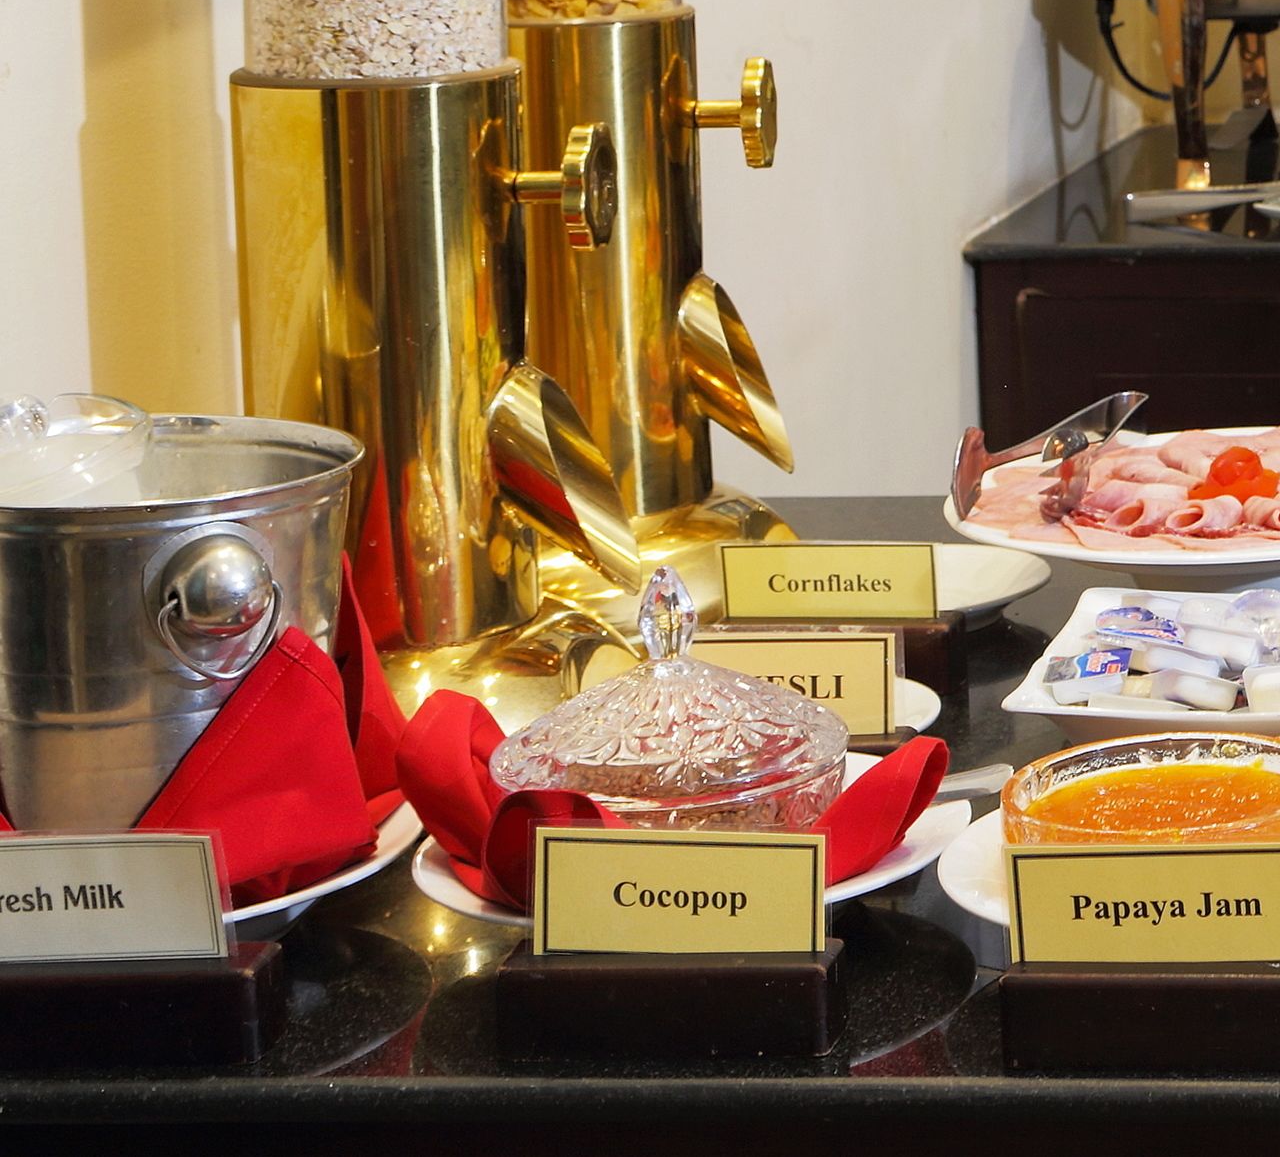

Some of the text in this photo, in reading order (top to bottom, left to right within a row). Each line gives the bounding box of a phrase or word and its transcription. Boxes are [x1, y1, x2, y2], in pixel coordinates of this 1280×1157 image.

[767, 573, 893, 594] Cornflakes
[0, 883, 125, 914] resh Milk
[612, 879, 749, 913] Cocopop
[1070, 891, 1263, 924] Papaya Jam
